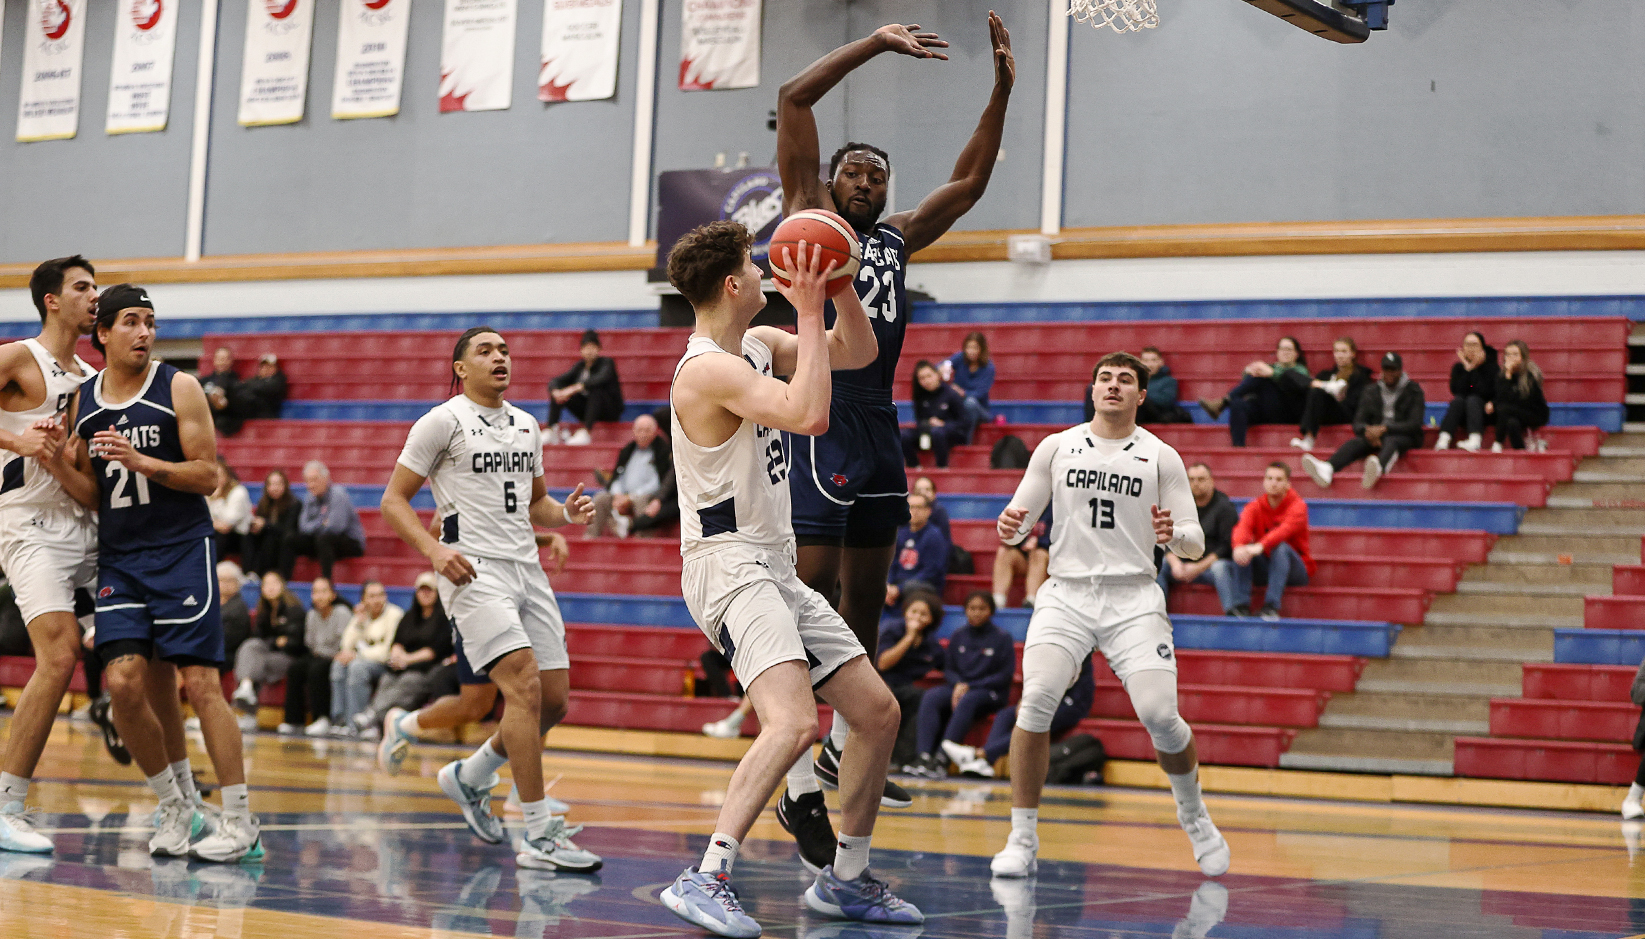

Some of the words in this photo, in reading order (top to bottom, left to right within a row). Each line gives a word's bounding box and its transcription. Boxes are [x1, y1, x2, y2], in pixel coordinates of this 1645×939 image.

[859, 265, 897, 323] 23
[105, 460, 151, 510] 21
[503, 480, 518, 514] 6
[1066, 468, 1143, 498] CAPILANO
[1088, 497, 1116, 530] 13
